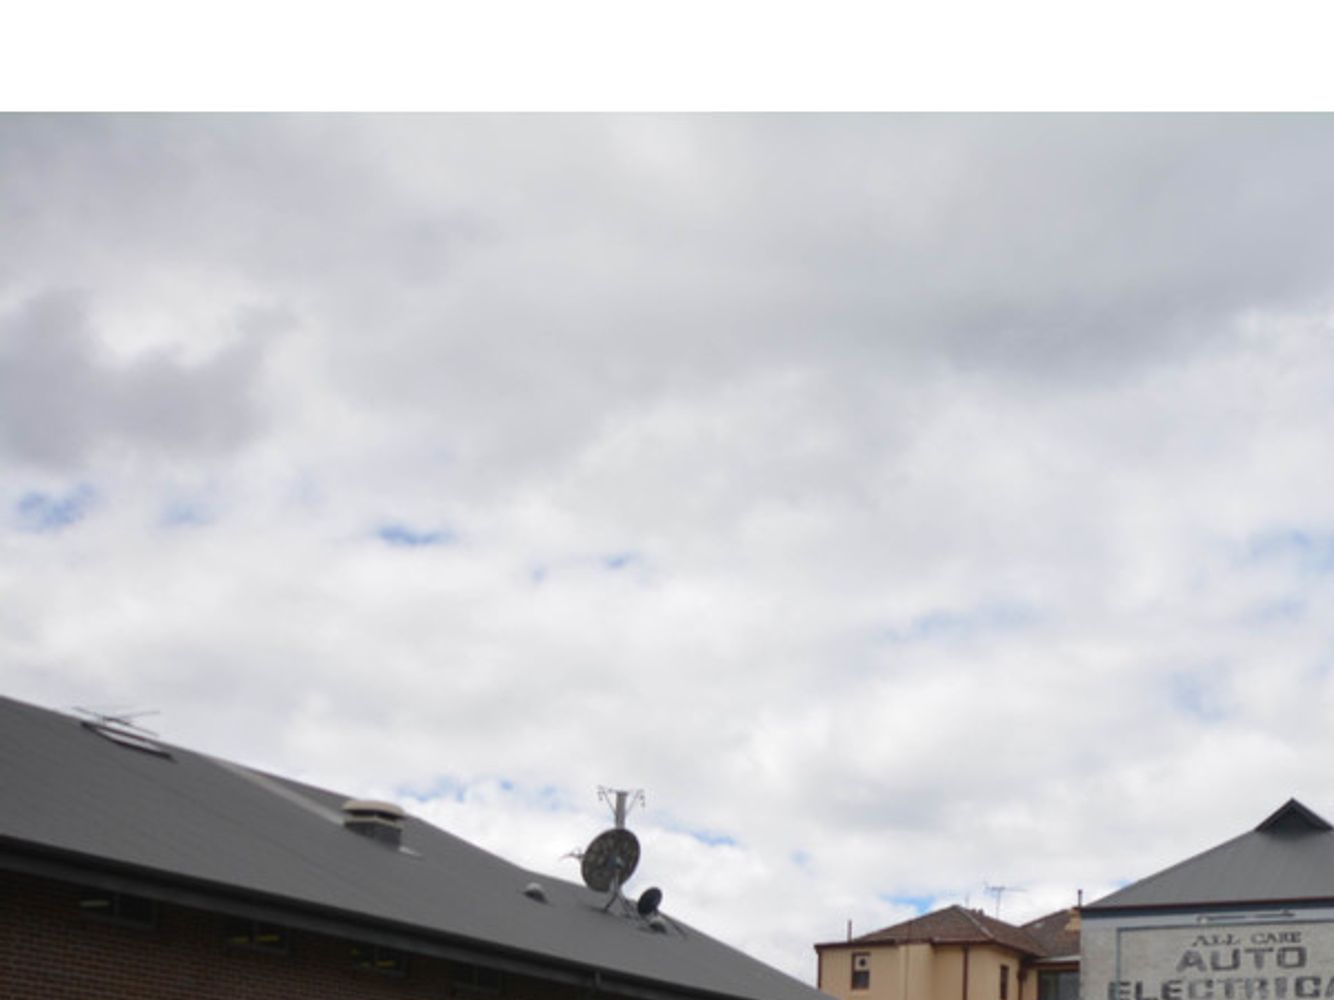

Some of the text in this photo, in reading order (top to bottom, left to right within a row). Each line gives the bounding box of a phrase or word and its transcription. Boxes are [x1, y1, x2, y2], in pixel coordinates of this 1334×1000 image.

[1192, 931, 1302, 947] ALL CARE
[1177, 946, 1307, 971] AUTO
